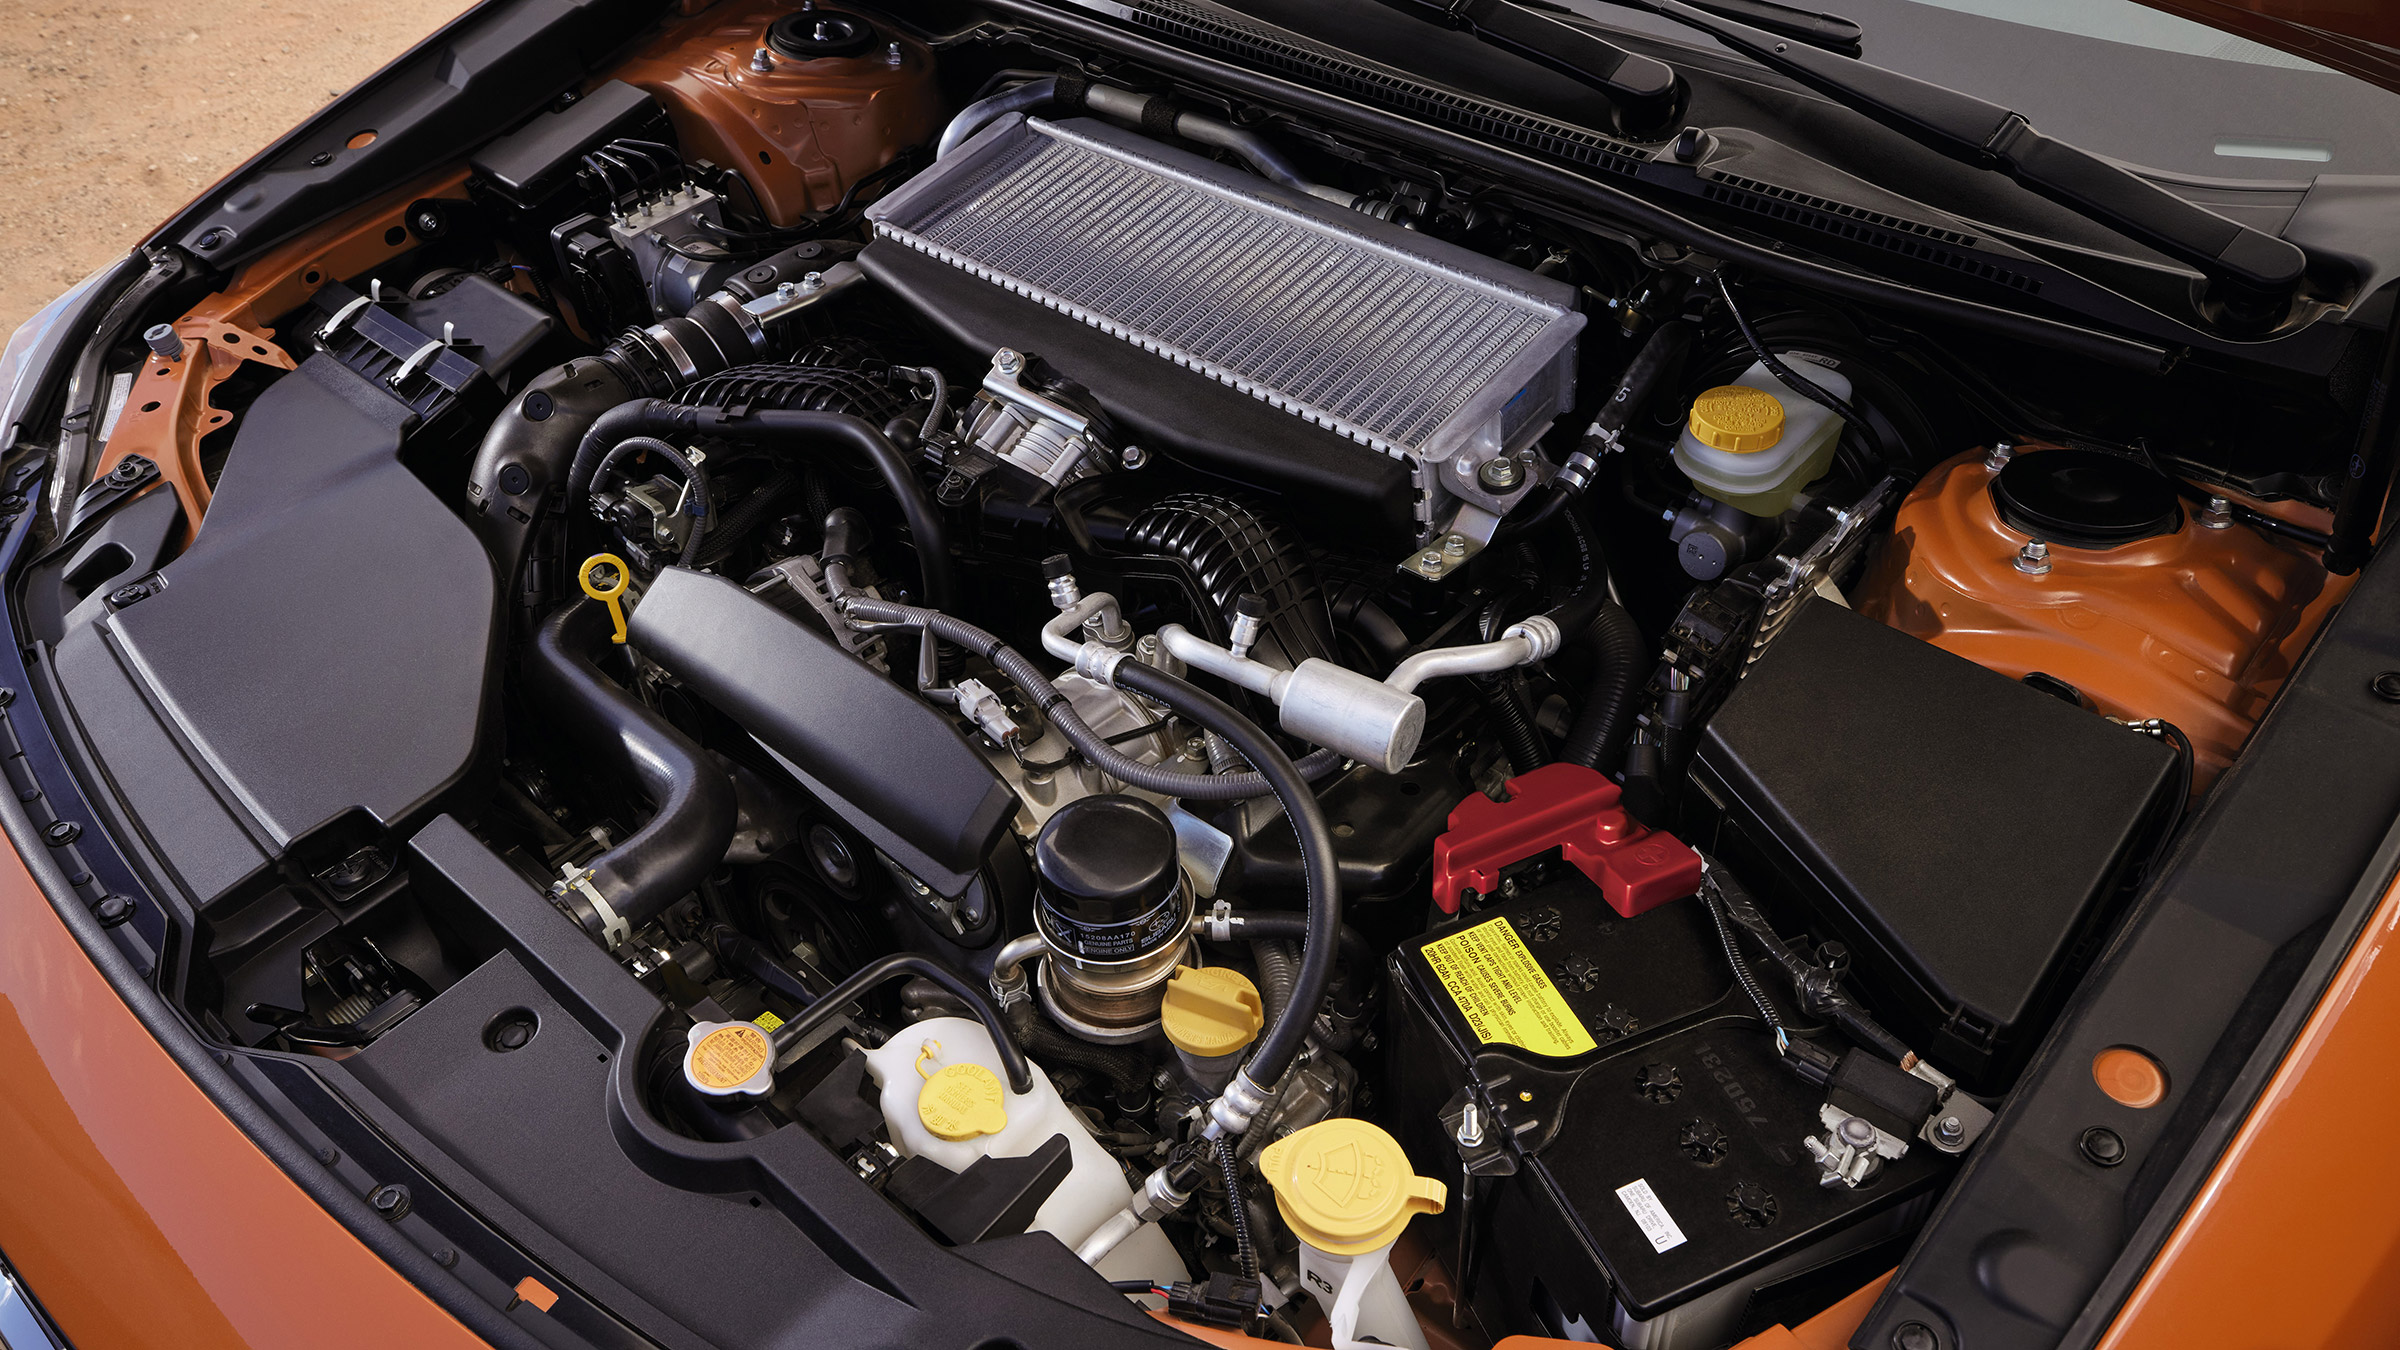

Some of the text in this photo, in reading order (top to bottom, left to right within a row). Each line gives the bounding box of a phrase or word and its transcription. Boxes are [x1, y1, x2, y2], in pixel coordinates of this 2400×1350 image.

[1615, 386, 1631, 402] 5
[1080, 931, 1136, 941] 15208AA170
[1141, 912, 1176, 944] SUBARU
[1086, 945, 1133, 954] ENGINE ONLY
[1112, 938, 1134, 946] PARTS
[1141, 937, 1158, 948] MADE
[1493, 920, 1547, 989] DANGER EXPLOSIVE GASES
[1435, 943, 1491, 1016] KEEP OUT OF REACH OF CHILDREN
[1455, 934, 1516, 1016] POISON CAUSES SEVERE BURNS
[1467, 931, 1523, 1004] KEEP VENT CAPS TIGHT AND LEVEL
[1424, 947, 1494, 1041] 20HR 62Ah CCA 470A D23(JIS)
[945, 1063, 999, 1103] COOLANT
[1266, 1147, 1281, 1174] PULL
[1655, 1235, 1668, 1245] U
[1306, 1269, 1333, 1295] R3
